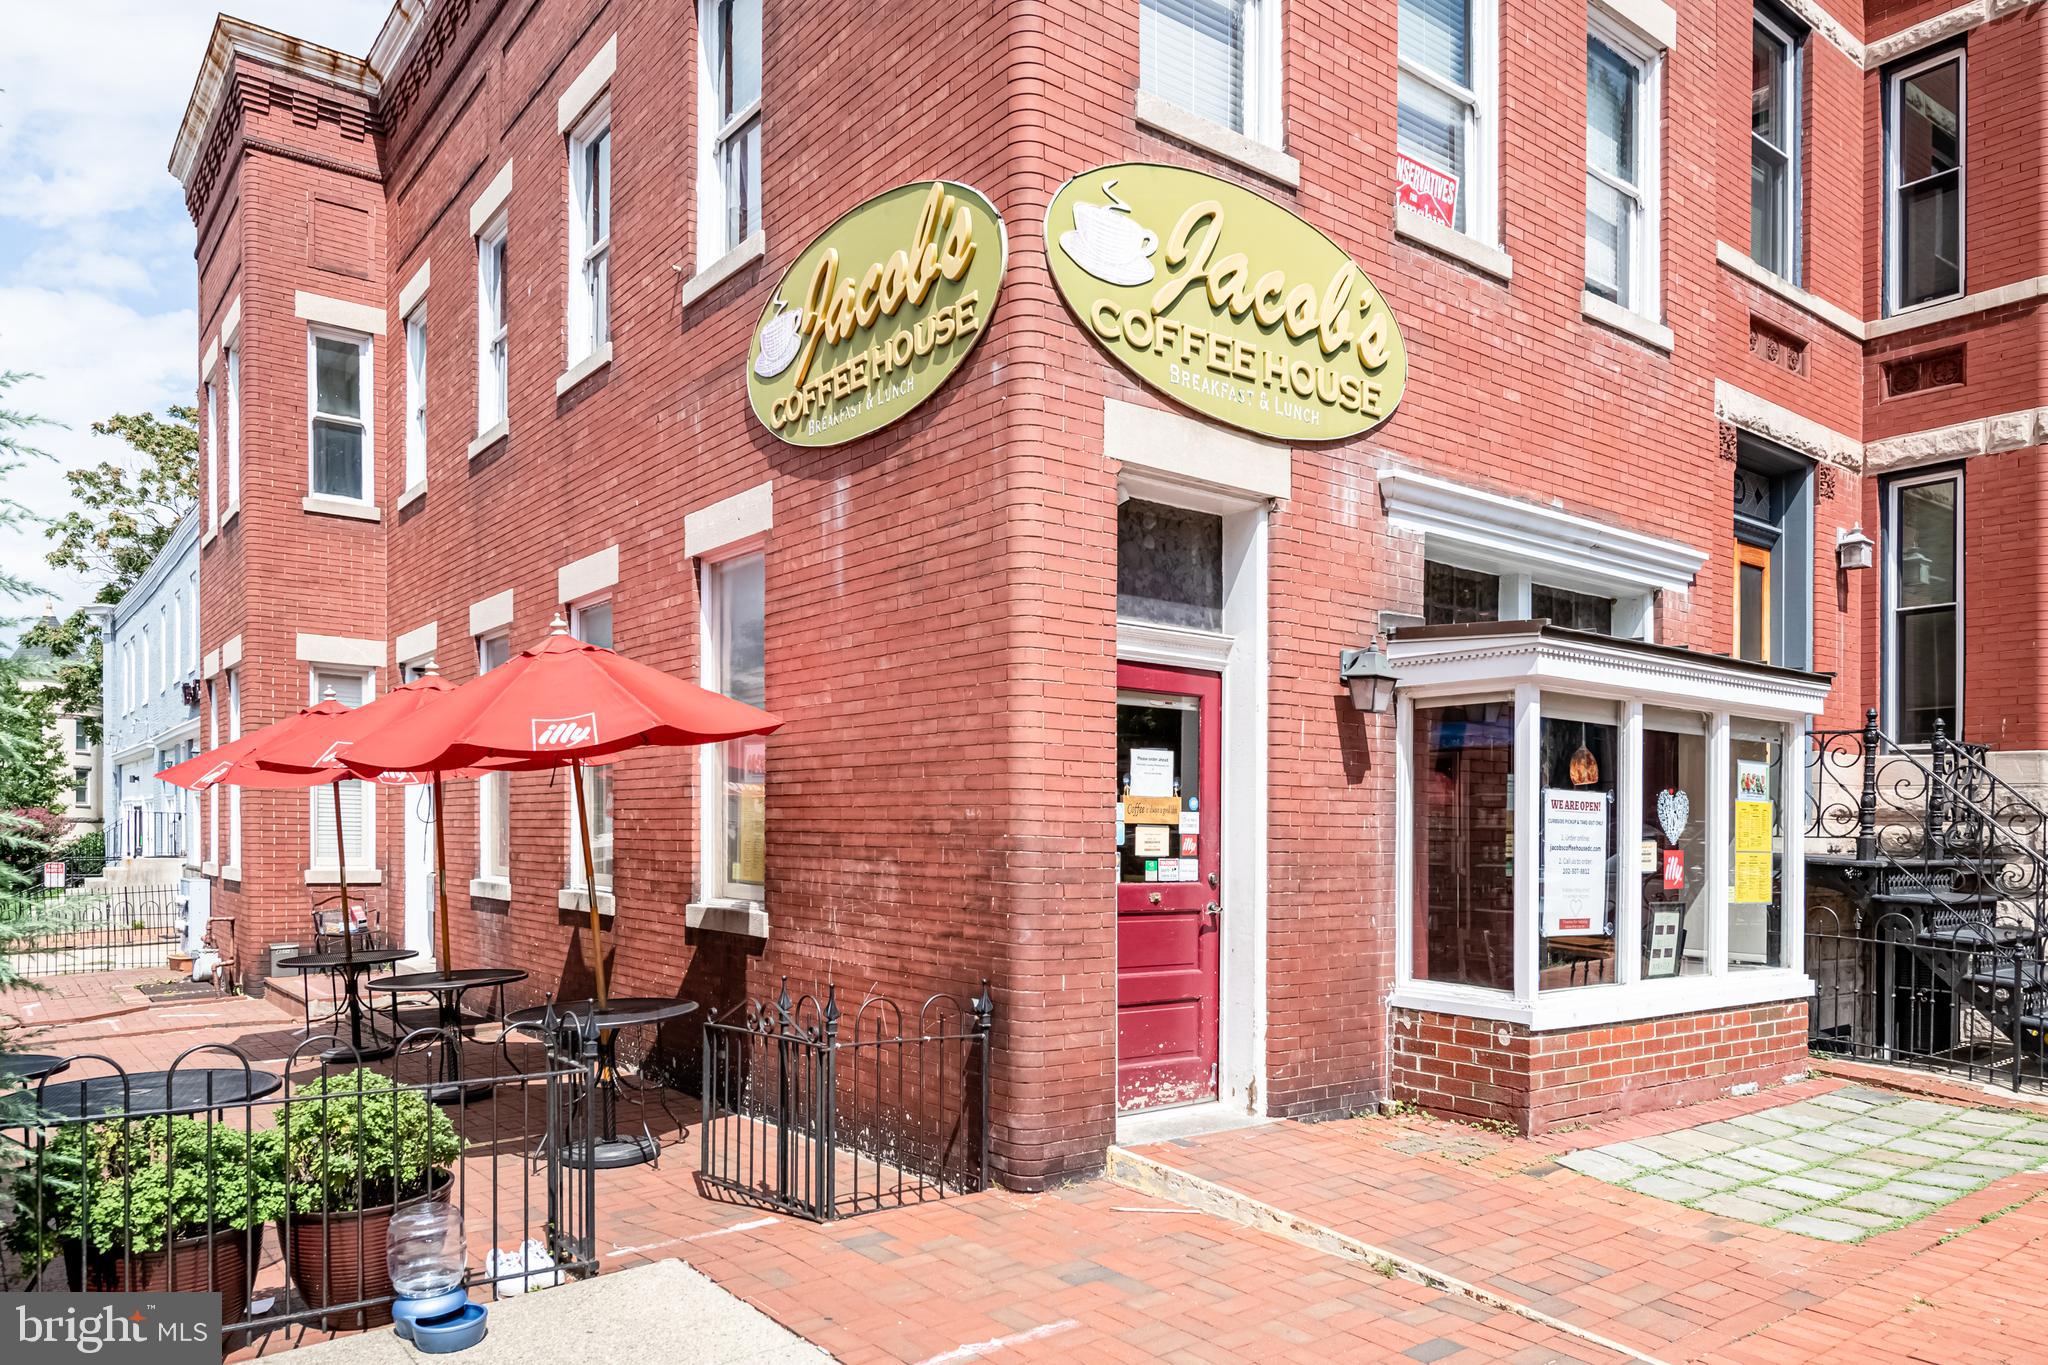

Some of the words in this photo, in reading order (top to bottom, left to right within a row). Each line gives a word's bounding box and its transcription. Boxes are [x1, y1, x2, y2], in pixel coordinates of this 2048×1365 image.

[795, 181, 978, 388] Jacob's
[1151, 200, 1391, 369] Jacob's
[770, 350, 869, 430] COFFEE
[872, 289, 979, 381] HOUSE
[1090, 298, 1257, 382] COFFEE
[1262, 350, 1383, 419] HOUSE
[808, 401, 863, 437] BREAKFAST
[866, 396, 874, 410] &
[877, 376, 915, 406] LUNCH
[1169, 363, 1254, 404] BREAKFAST
[1260, 393, 1269, 410] &
[1274, 395, 1321, 425] LUNCH
[537, 722, 592, 747] illy
[1127, 802, 1144, 817] Coffee
[1551, 800, 1564, 810] WE
[1564, 800, 1579, 810] ARE
[1580, 801, 1601, 812] OPEN!
[1182, 837, 1198, 854] illy
[1665, 855, 1683, 885] illy
